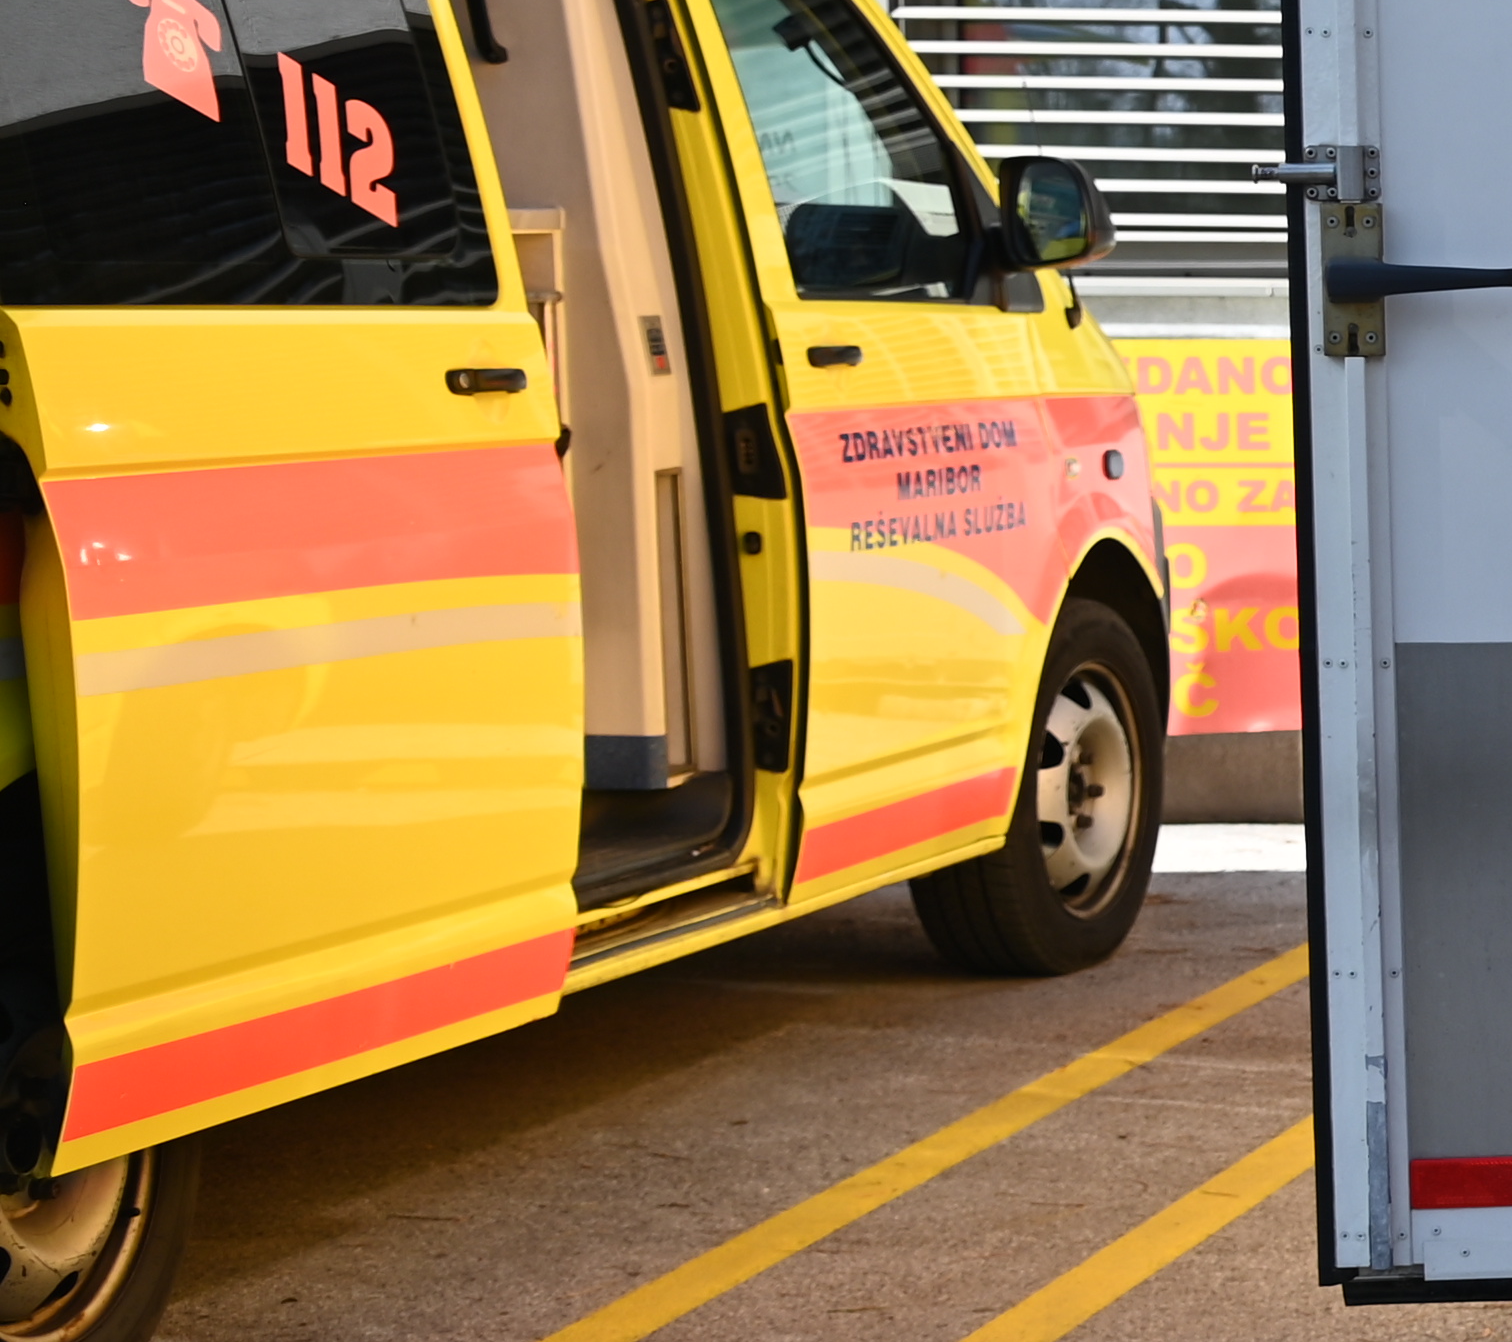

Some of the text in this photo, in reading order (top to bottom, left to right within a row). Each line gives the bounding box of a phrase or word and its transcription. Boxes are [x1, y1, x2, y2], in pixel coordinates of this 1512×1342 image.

[277, 51, 398, 228] 112
[1123, 356, 1293, 396] DANO
[839, 421, 1018, 463] ZDRAVSTVENI DOM
[897, 464, 981, 500] MARIBOR
[1236, 479, 1296, 513] ZA
[850, 496, 1027, 552] REŠEVALNA SLUŽBA
